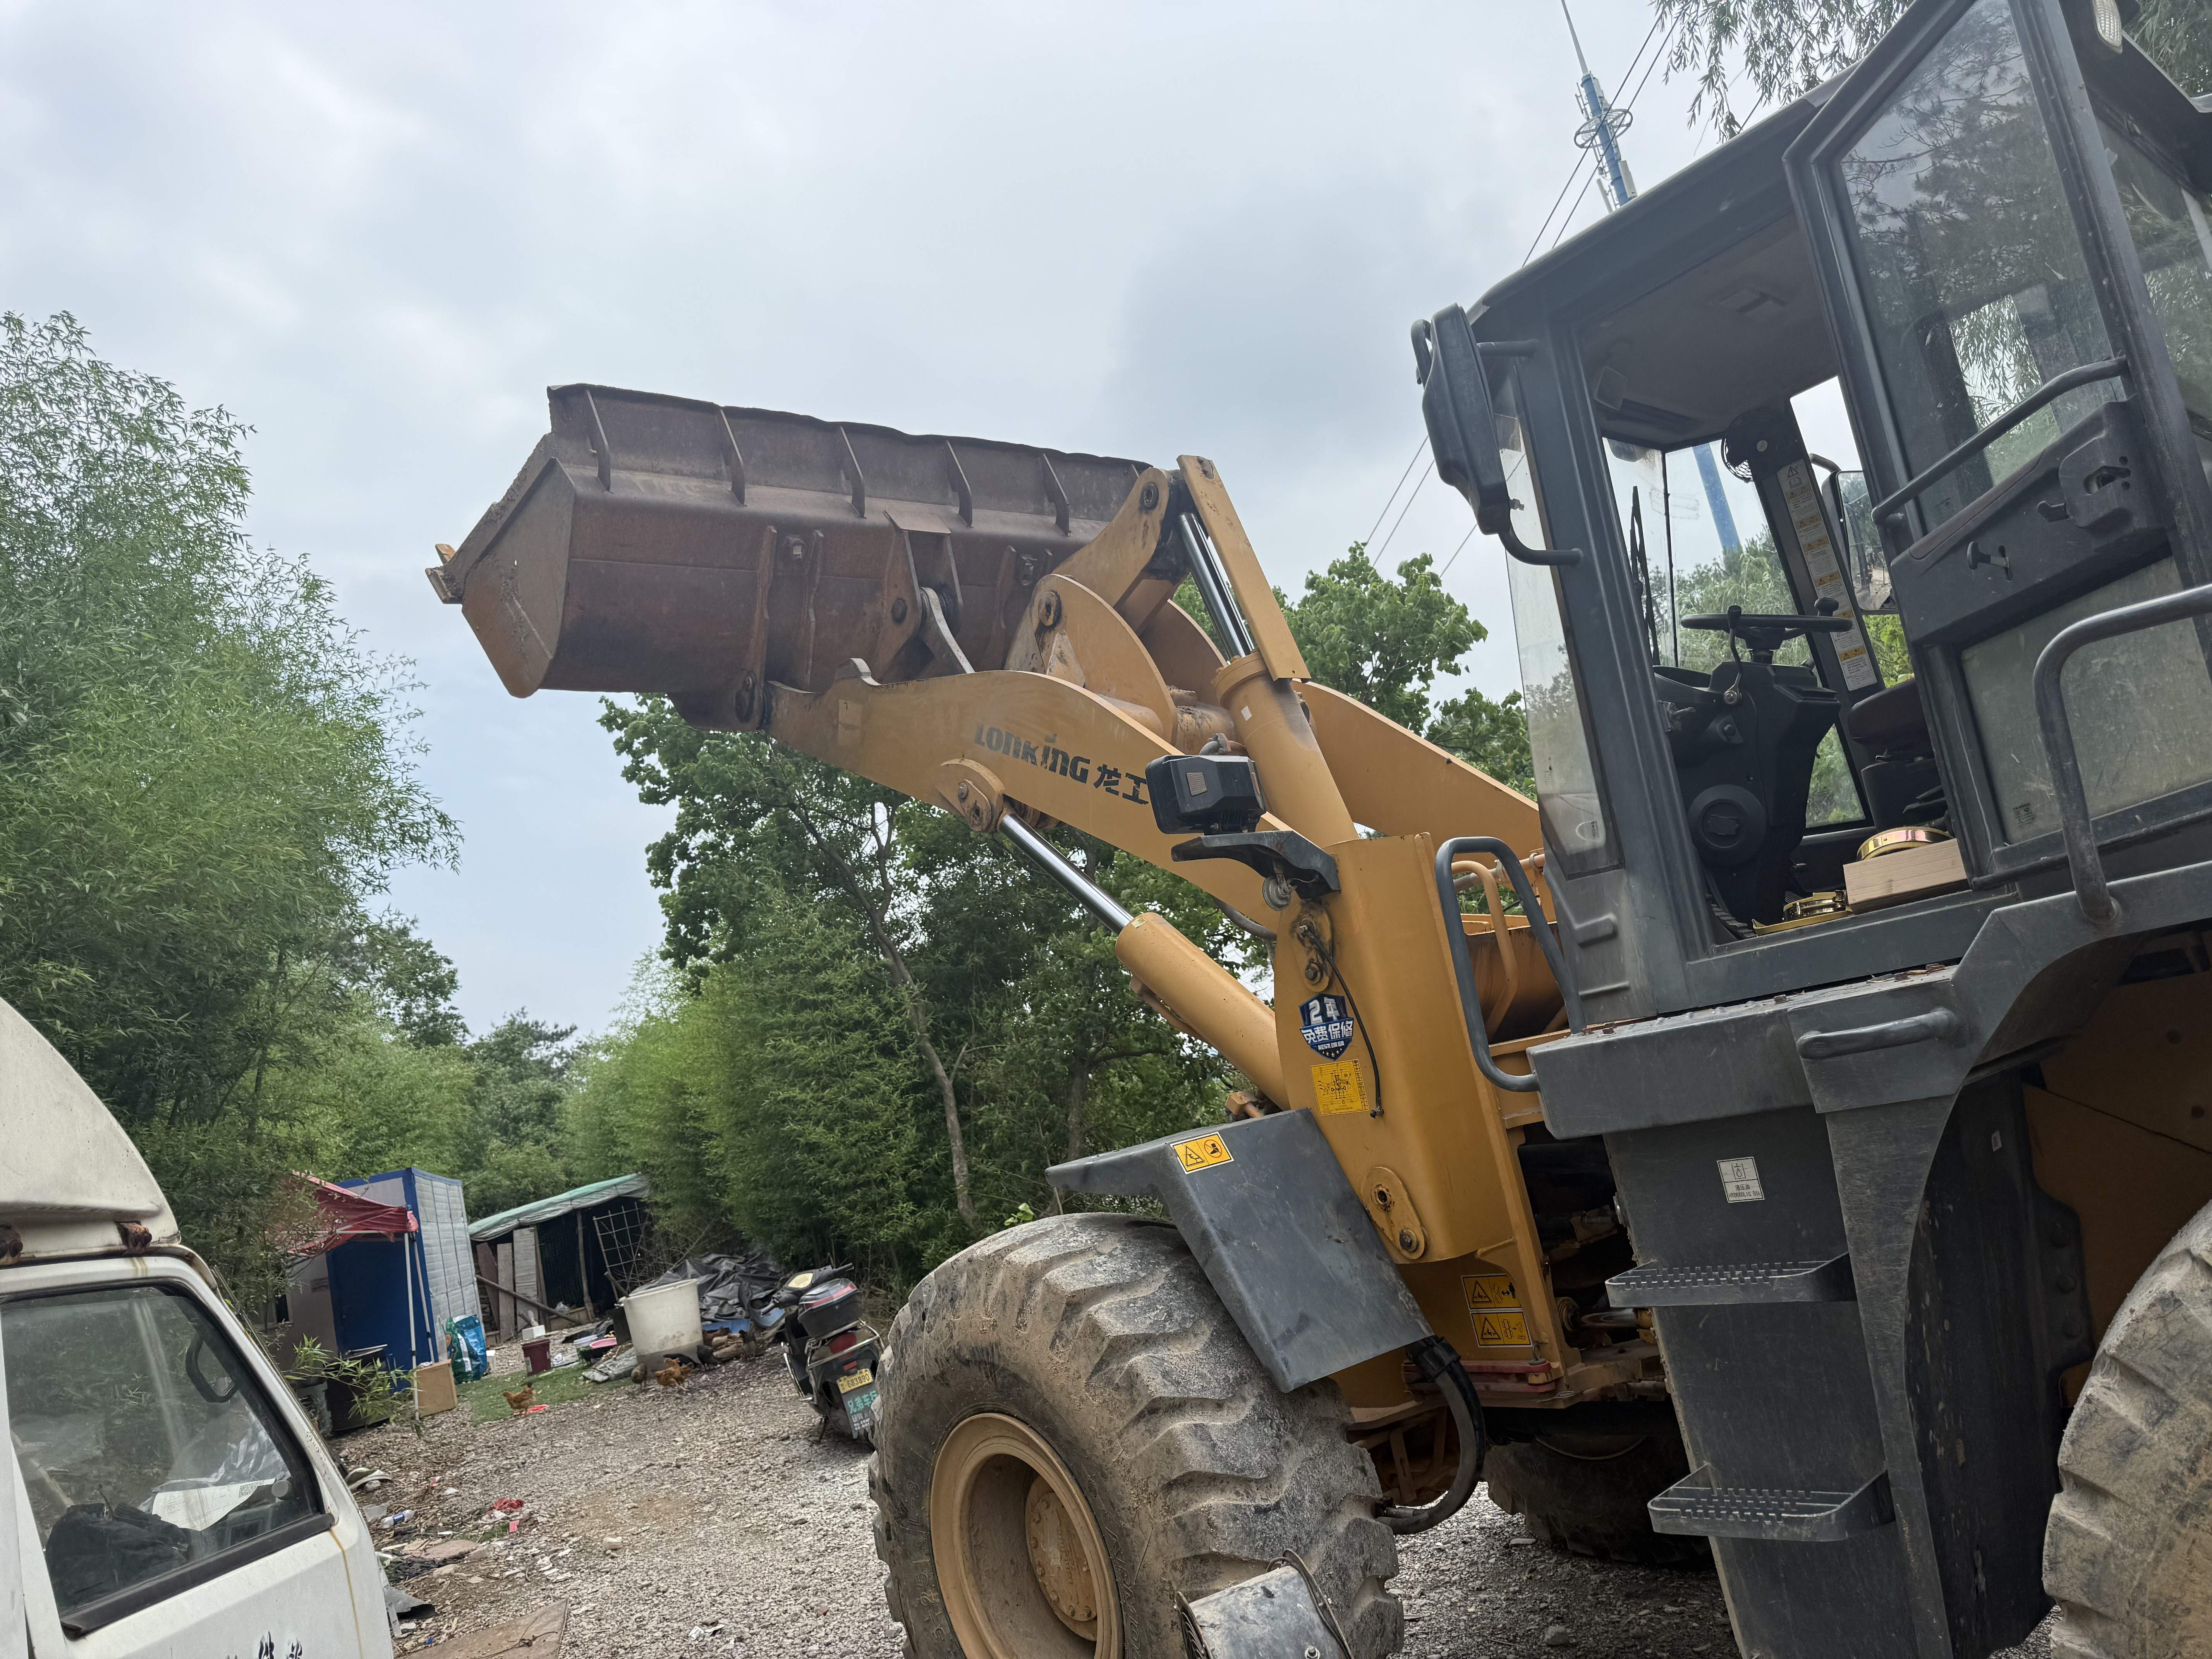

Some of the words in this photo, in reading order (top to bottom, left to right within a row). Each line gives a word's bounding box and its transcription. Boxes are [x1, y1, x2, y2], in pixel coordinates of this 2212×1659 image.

[1093, 764, 1149, 805] 龙工
[1309, 996, 1340, 1025] 2年
[1301, 1020, 1353, 1044] 免费保修
